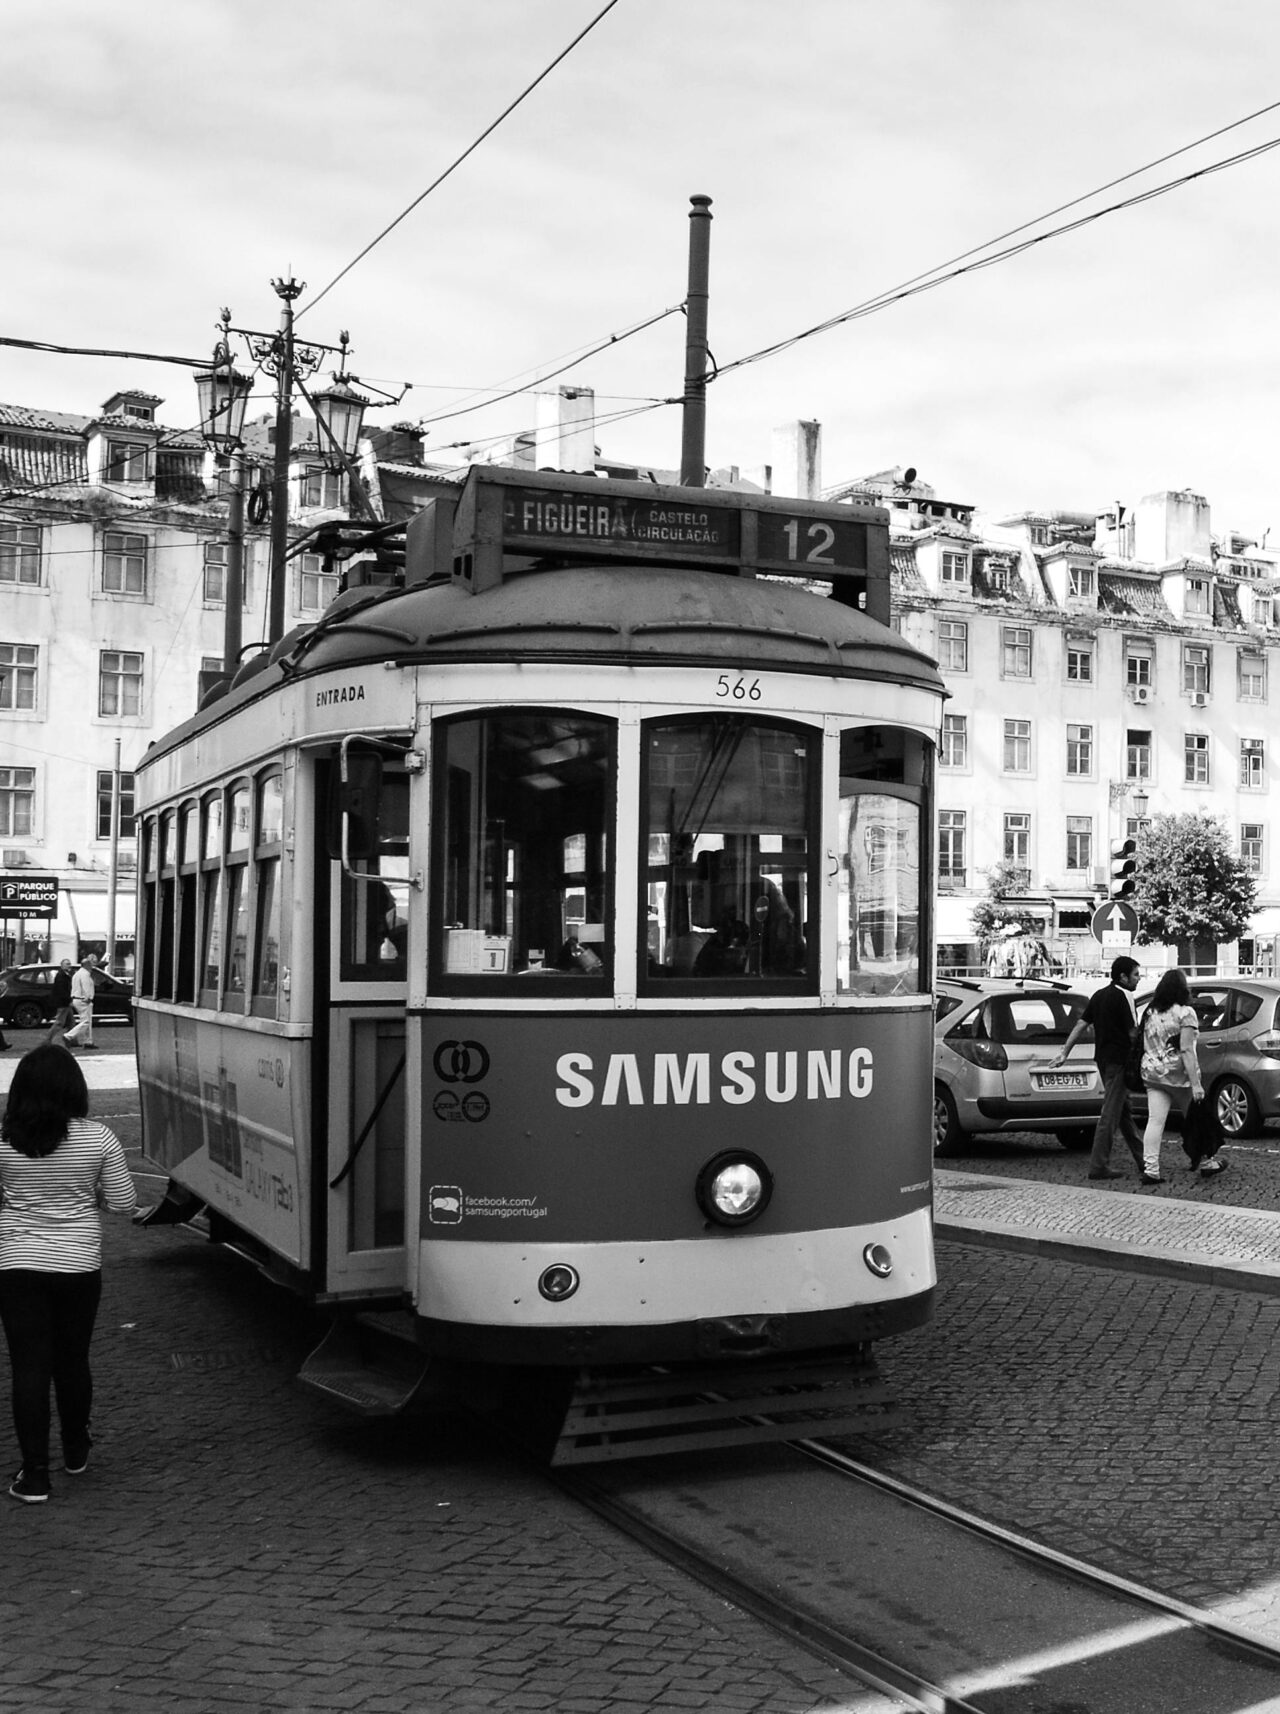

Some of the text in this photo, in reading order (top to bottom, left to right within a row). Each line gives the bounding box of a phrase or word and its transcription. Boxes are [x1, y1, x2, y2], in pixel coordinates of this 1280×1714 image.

[522, 501, 629, 537] FIGUEIRA
[649, 510, 709, 526] CASTELO
[783, 519, 835, 565] 12
[316, 685, 365, 707] ENTRADA
[716, 675, 761, 700] 566
[19, 882, 54, 891] PARQUE
[19, 891, 58, 901] PÚBLICO
[555, 1047, 873, 1108] SAMSUNG
[465, 1196, 537, 1206] facebook.com/
[465, 1207, 548, 1218] samsungportugal
